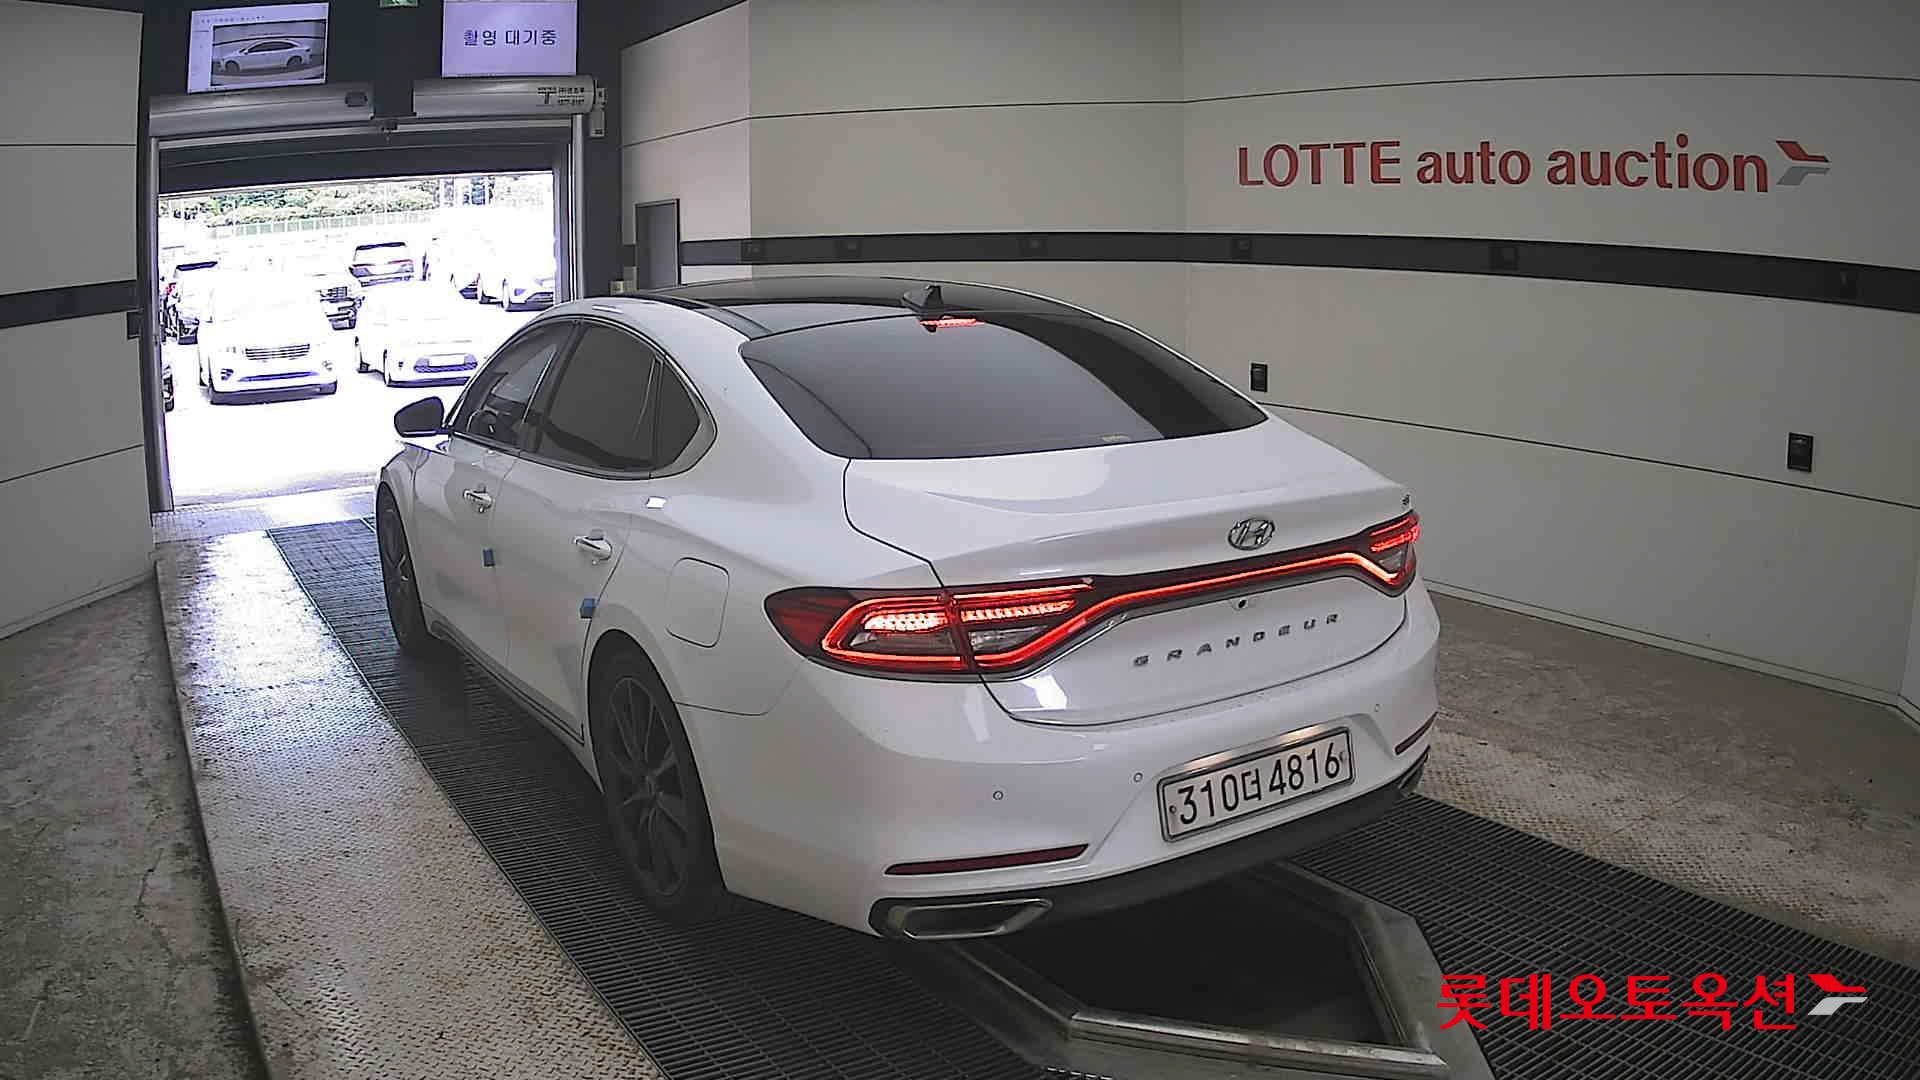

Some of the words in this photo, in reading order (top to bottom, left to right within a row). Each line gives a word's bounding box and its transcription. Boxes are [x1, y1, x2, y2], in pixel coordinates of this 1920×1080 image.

[505, 29, 558, 46] 대기중
[1238, 140, 1401, 186] LOTTE
[1417, 141, 1531, 185] auto
[1547, 133, 1769, 193] auction
[1134, 613, 1338, 667] GRANDEUR
[1177, 742, 1340, 825] 310더4816
